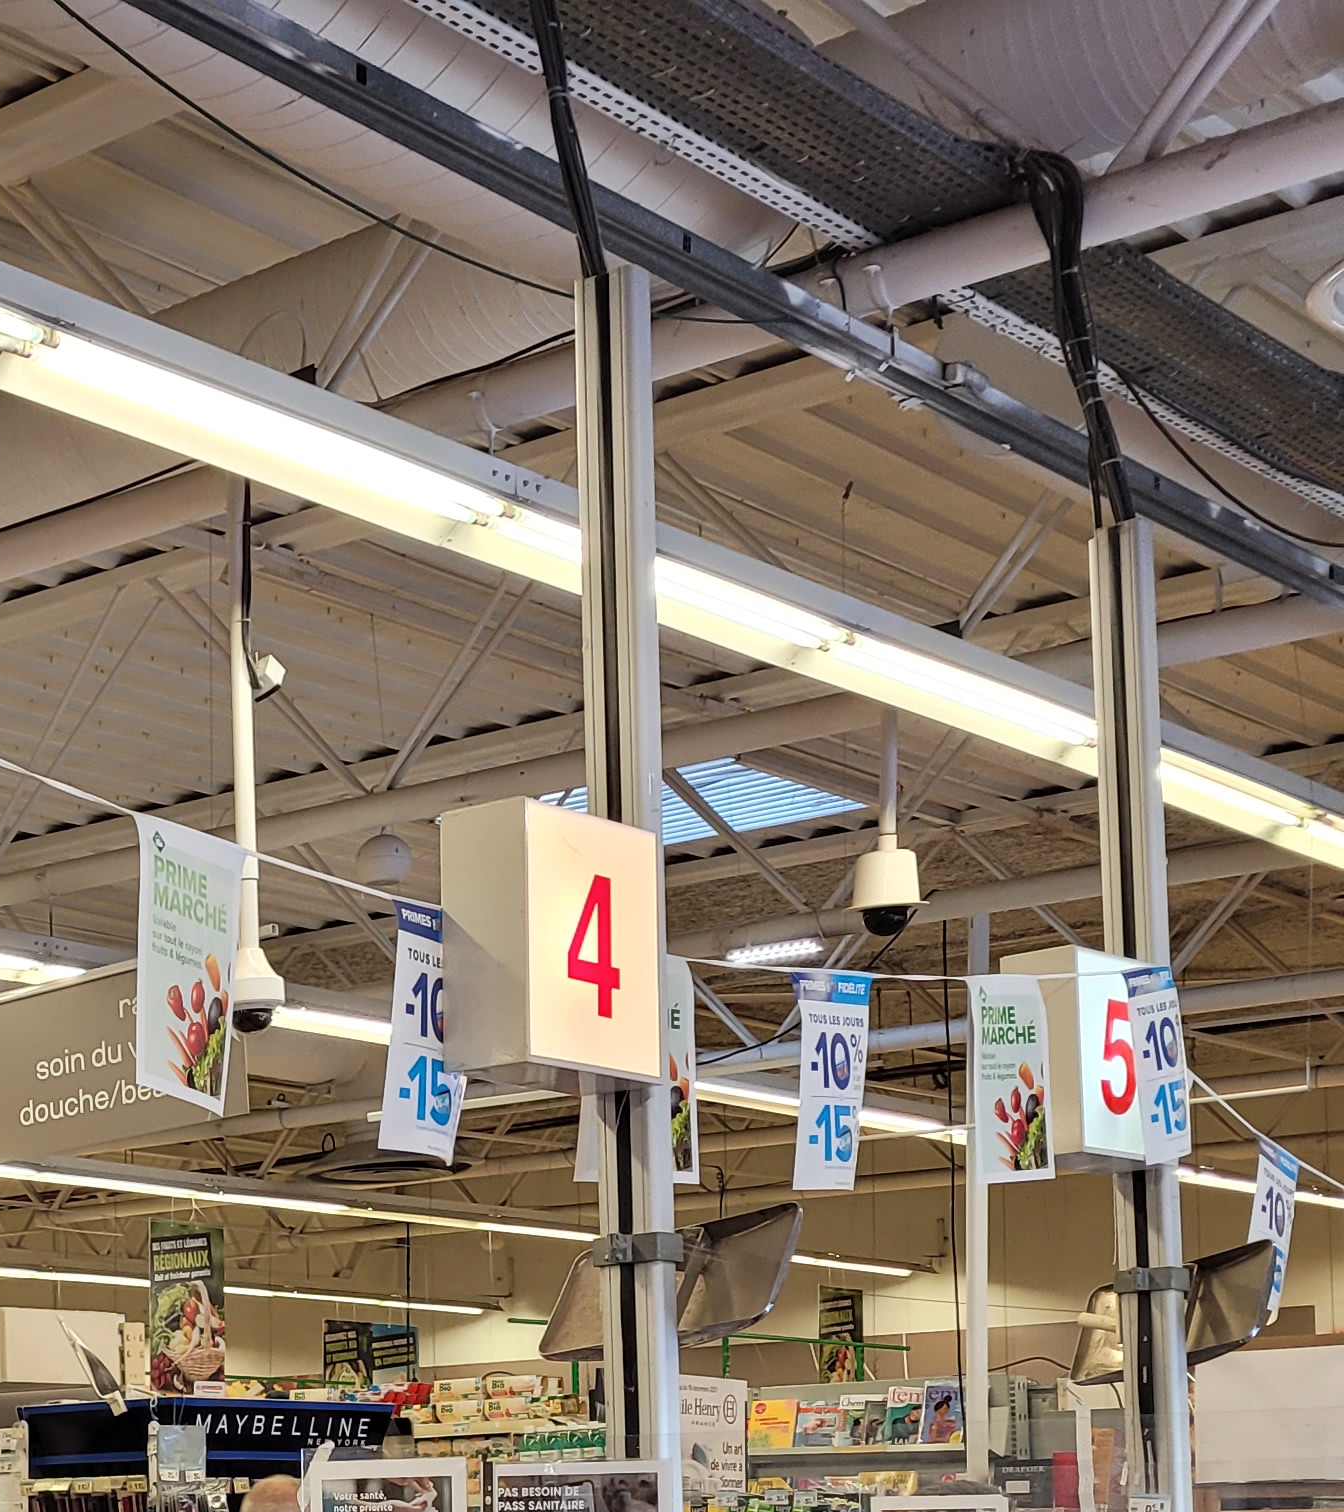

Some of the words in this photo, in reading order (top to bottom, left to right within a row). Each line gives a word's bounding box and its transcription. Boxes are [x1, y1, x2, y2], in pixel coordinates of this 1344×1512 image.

[154, 855, 208, 898] PRIME
[153, 883, 227, 934] MARCHÉ
[401, 907, 432, 928] PRIMES
[567, 874, 620, 1019] 4
[809, 1013, 828, 1024] TOUS
[829, 1015, 840, 1025] LES
[842, 1016, 864, 1028] JOURS
[981, 1006, 1016, 1025] PRIME
[981, 1020, 1036, 1045] MARCHÉ
[36, 1049, 85, 1079] soin
[92, 1041, 122, 1067] du
[1101, 999, 1137, 1115] 5
[694, 1398, 722, 1422] Henry
[195, 1413, 371, 1438] MAYBELLINE
[333, 1492, 358, 1500] Votre
[360, 1490, 387, 1500] santé,
[498, 1488, 518, 1497] PAS
[522, 1487, 562, 1497] BESOIN
[565, 1486, 579, 1496] DE
[498, 1501, 525, 1511] PASS
[528, 1500, 585, 1510] SANITAIRE
